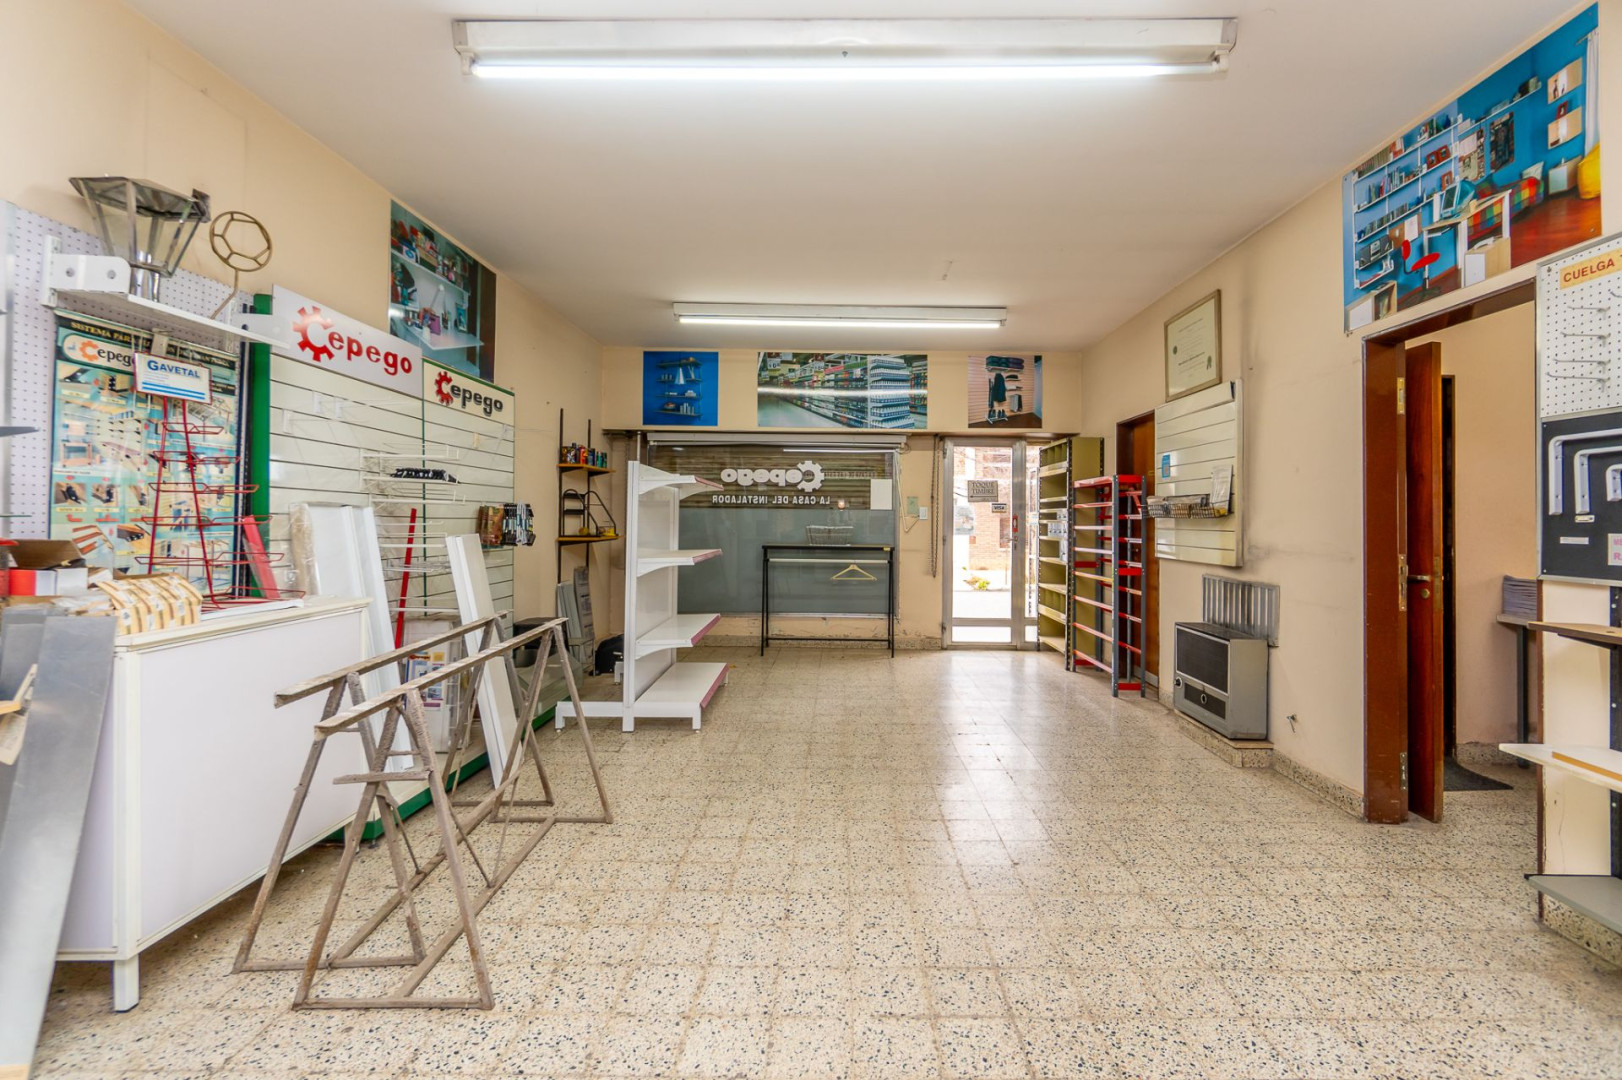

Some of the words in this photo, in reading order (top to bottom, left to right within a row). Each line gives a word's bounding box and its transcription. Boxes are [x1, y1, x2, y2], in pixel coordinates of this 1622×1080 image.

[1563, 258, 1615, 283] CUELGA
[79, 340, 135, 367] Cepeg
[293, 305, 412, 375] Cepego
[147, 360, 201, 378] GAVETAL
[434, 371, 504, 416] Cepego
